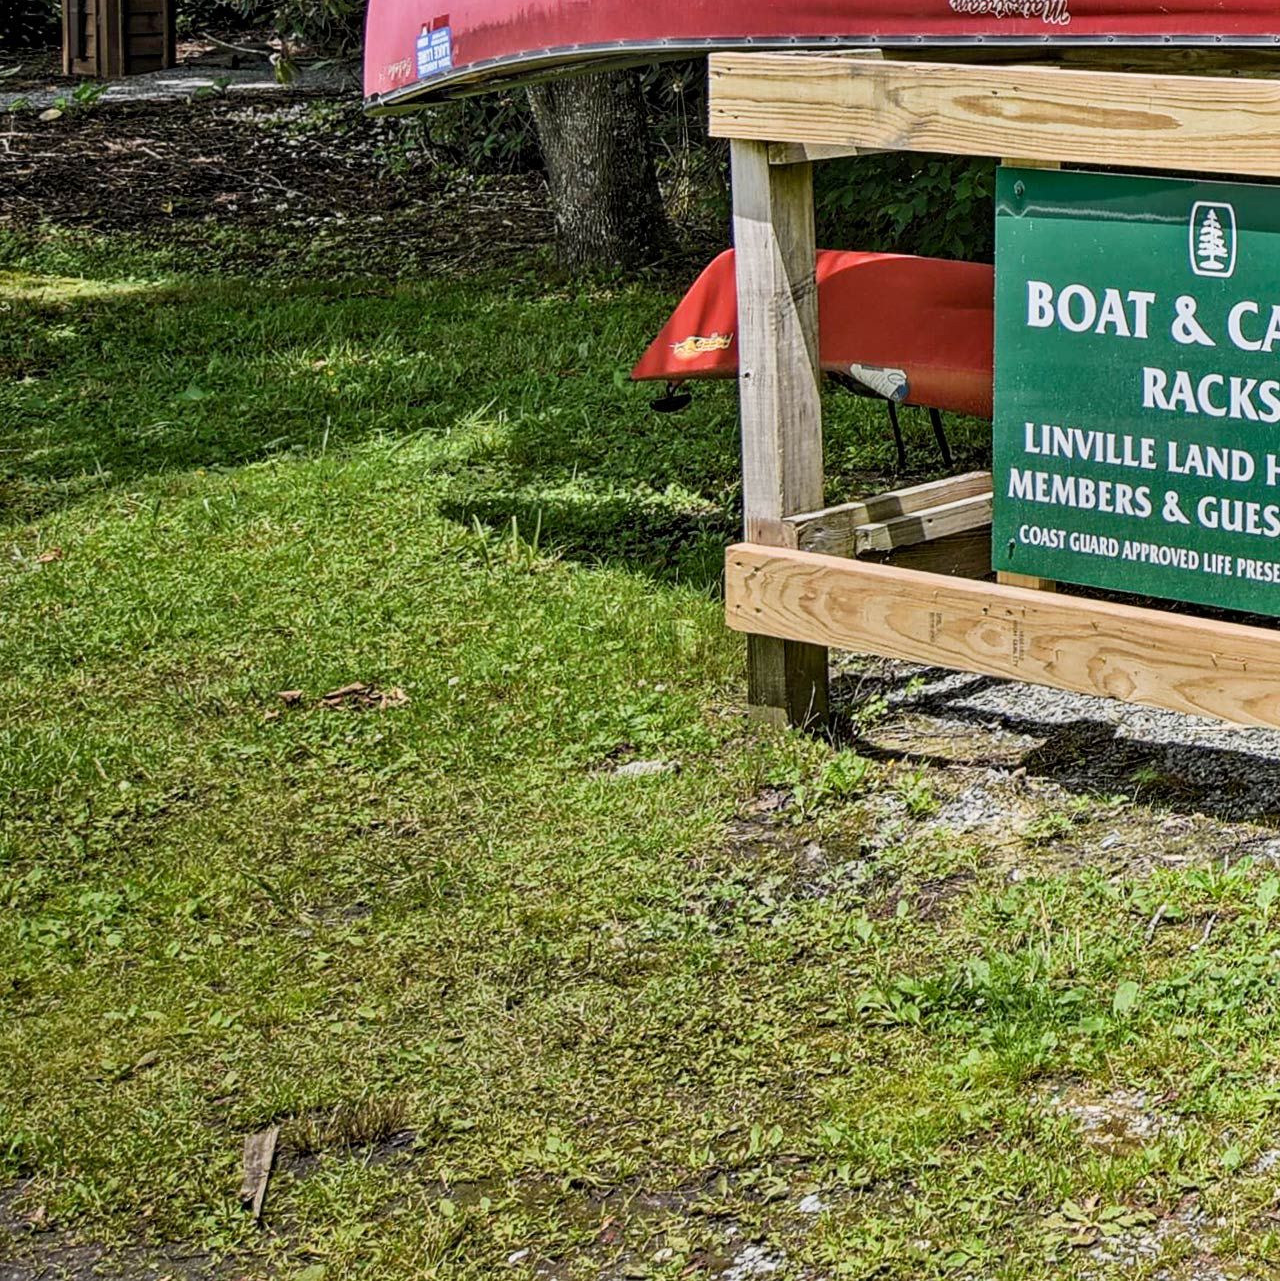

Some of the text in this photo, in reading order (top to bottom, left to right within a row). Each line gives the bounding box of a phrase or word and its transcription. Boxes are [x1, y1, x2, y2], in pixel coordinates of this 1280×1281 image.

[1026, 280, 1155, 339] BOAT
[1171, 296, 1216, 346] &
[1024, 422, 1157, 470] LINVILLE
[1167, 441, 1255, 482] LAND
[1008, 469, 1152, 518] MEMBERS
[1162, 492, 1191, 525] &
[1019, 524, 1066, 551] COAST
[1070, 531, 1119, 557] GUARD
[1123, 539, 1200, 570] APPROVED
[1204, 552, 1233, 576] LIFE
